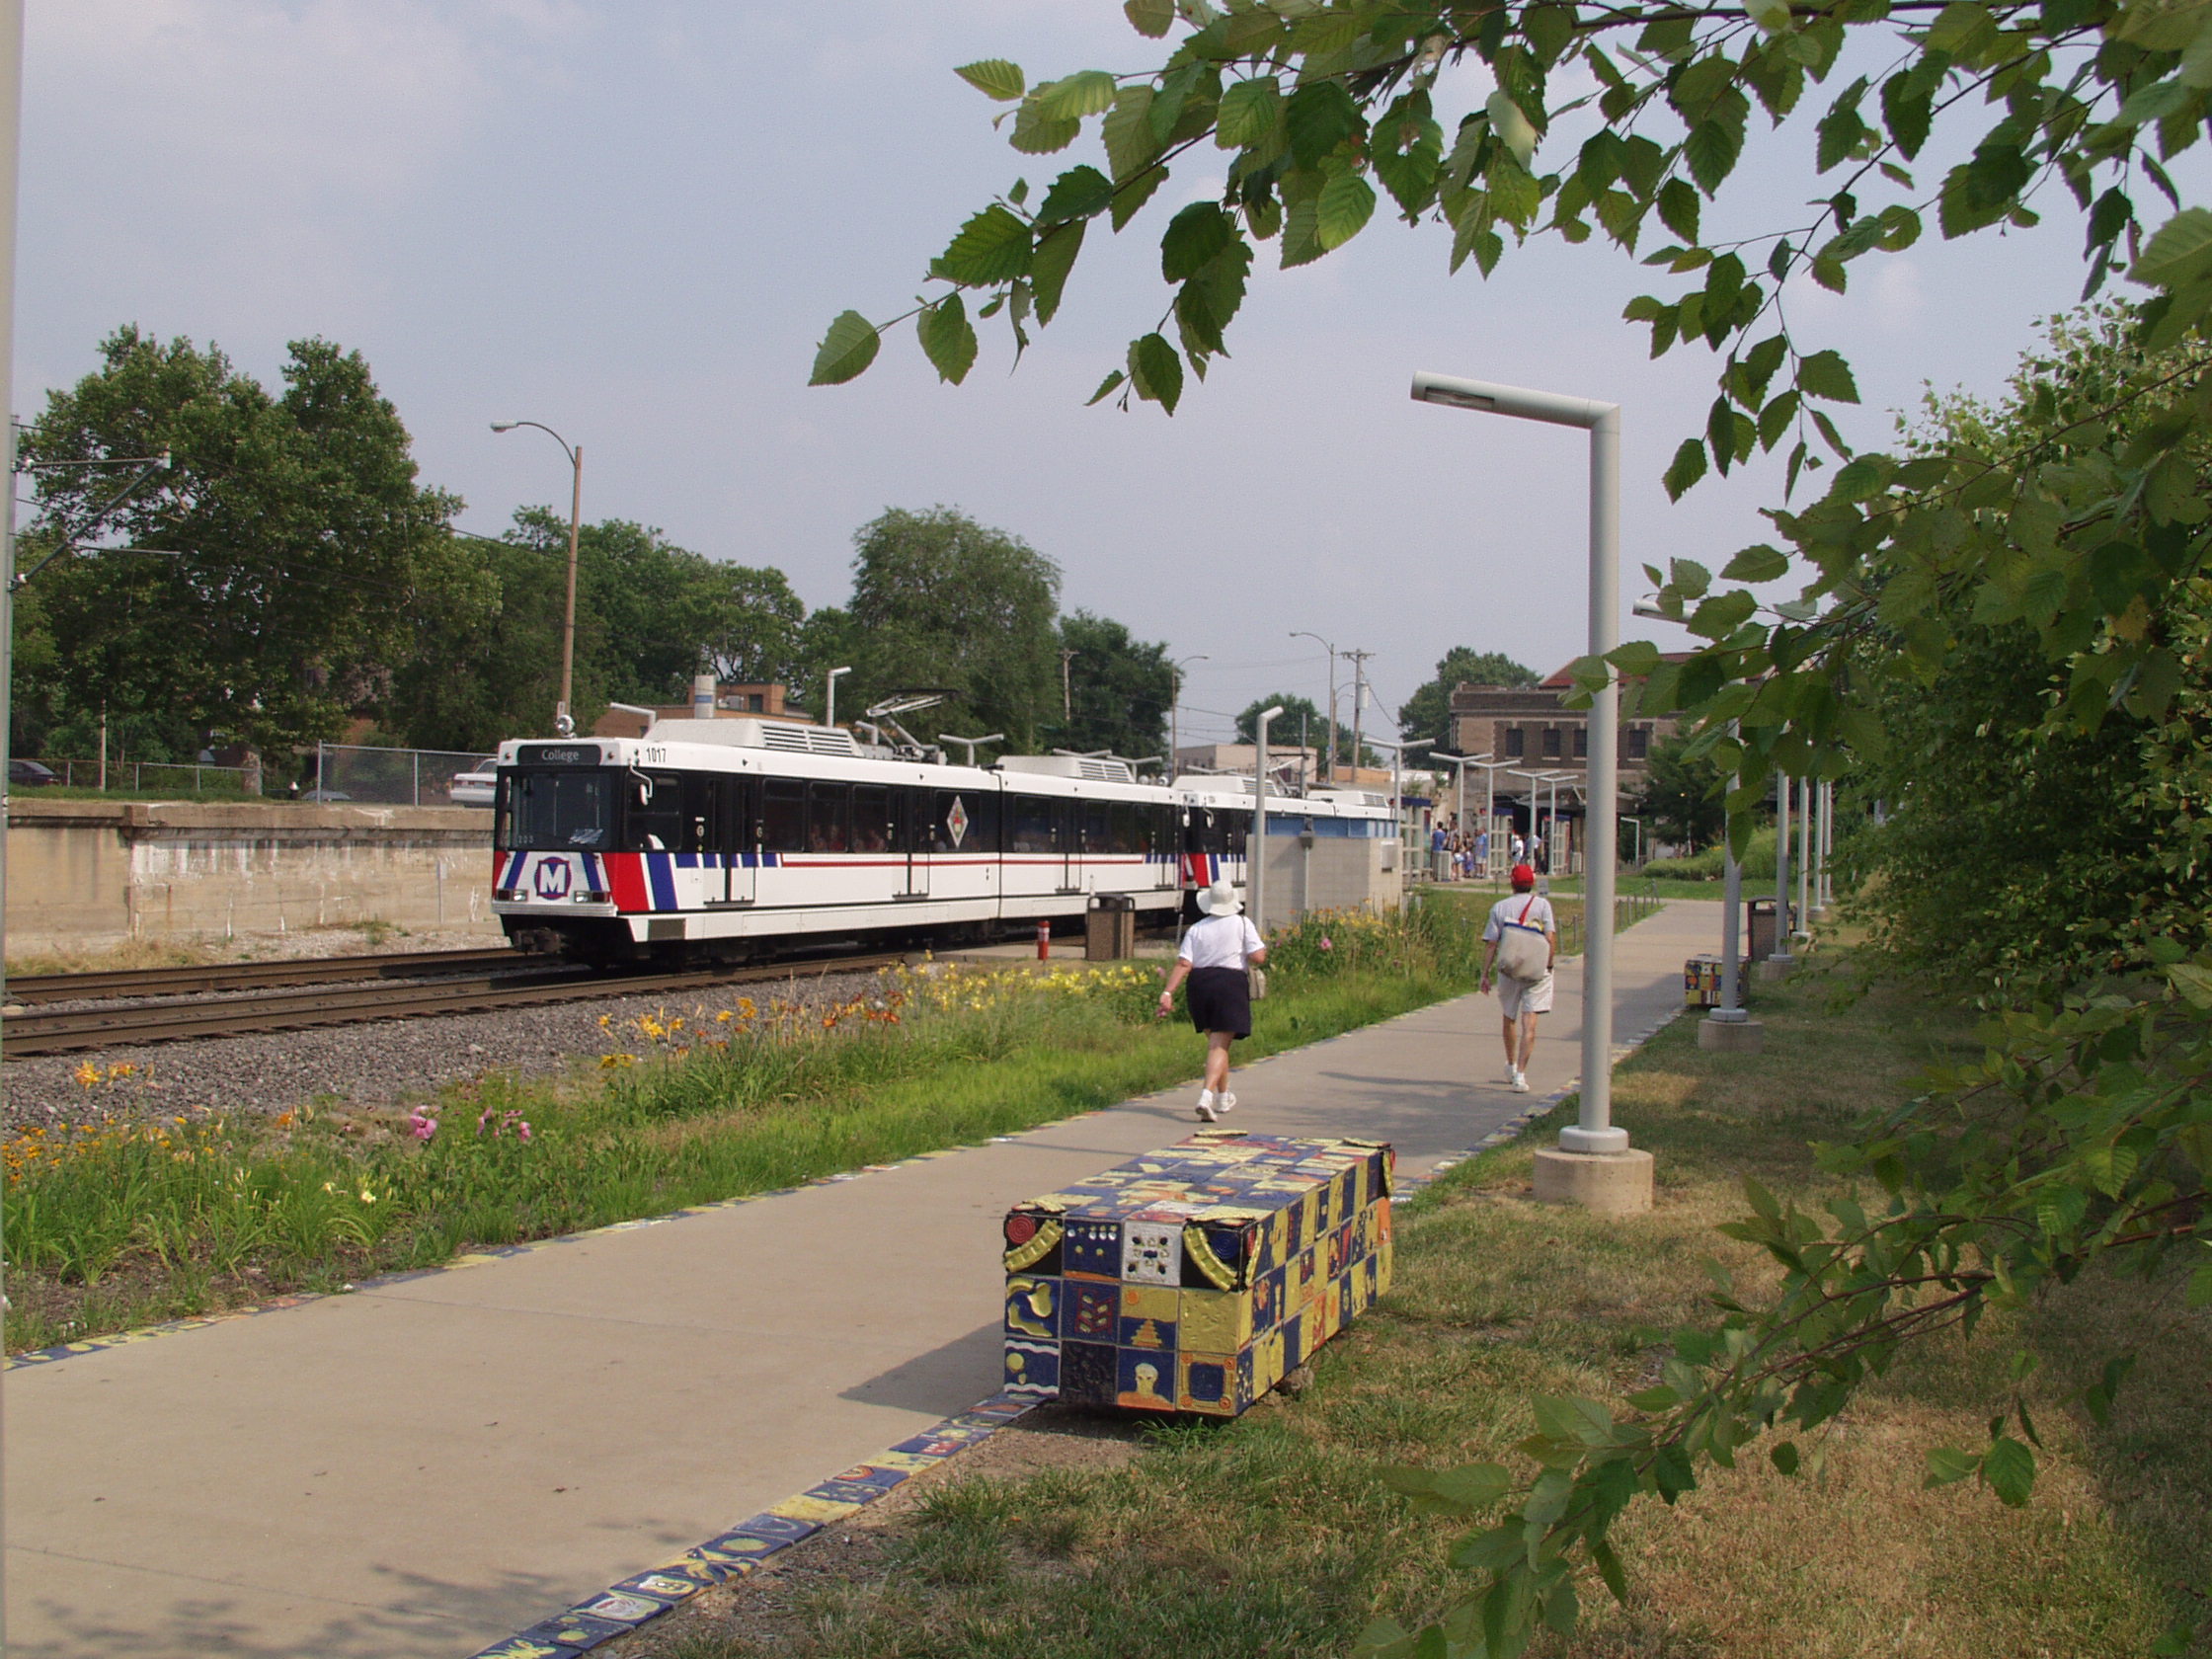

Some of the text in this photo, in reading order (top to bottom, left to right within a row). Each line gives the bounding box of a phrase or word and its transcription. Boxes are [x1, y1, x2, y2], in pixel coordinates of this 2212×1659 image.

[541, 749, 580, 762] College
[646, 748, 667, 763] 1017
[539, 863, 567, 894] M
